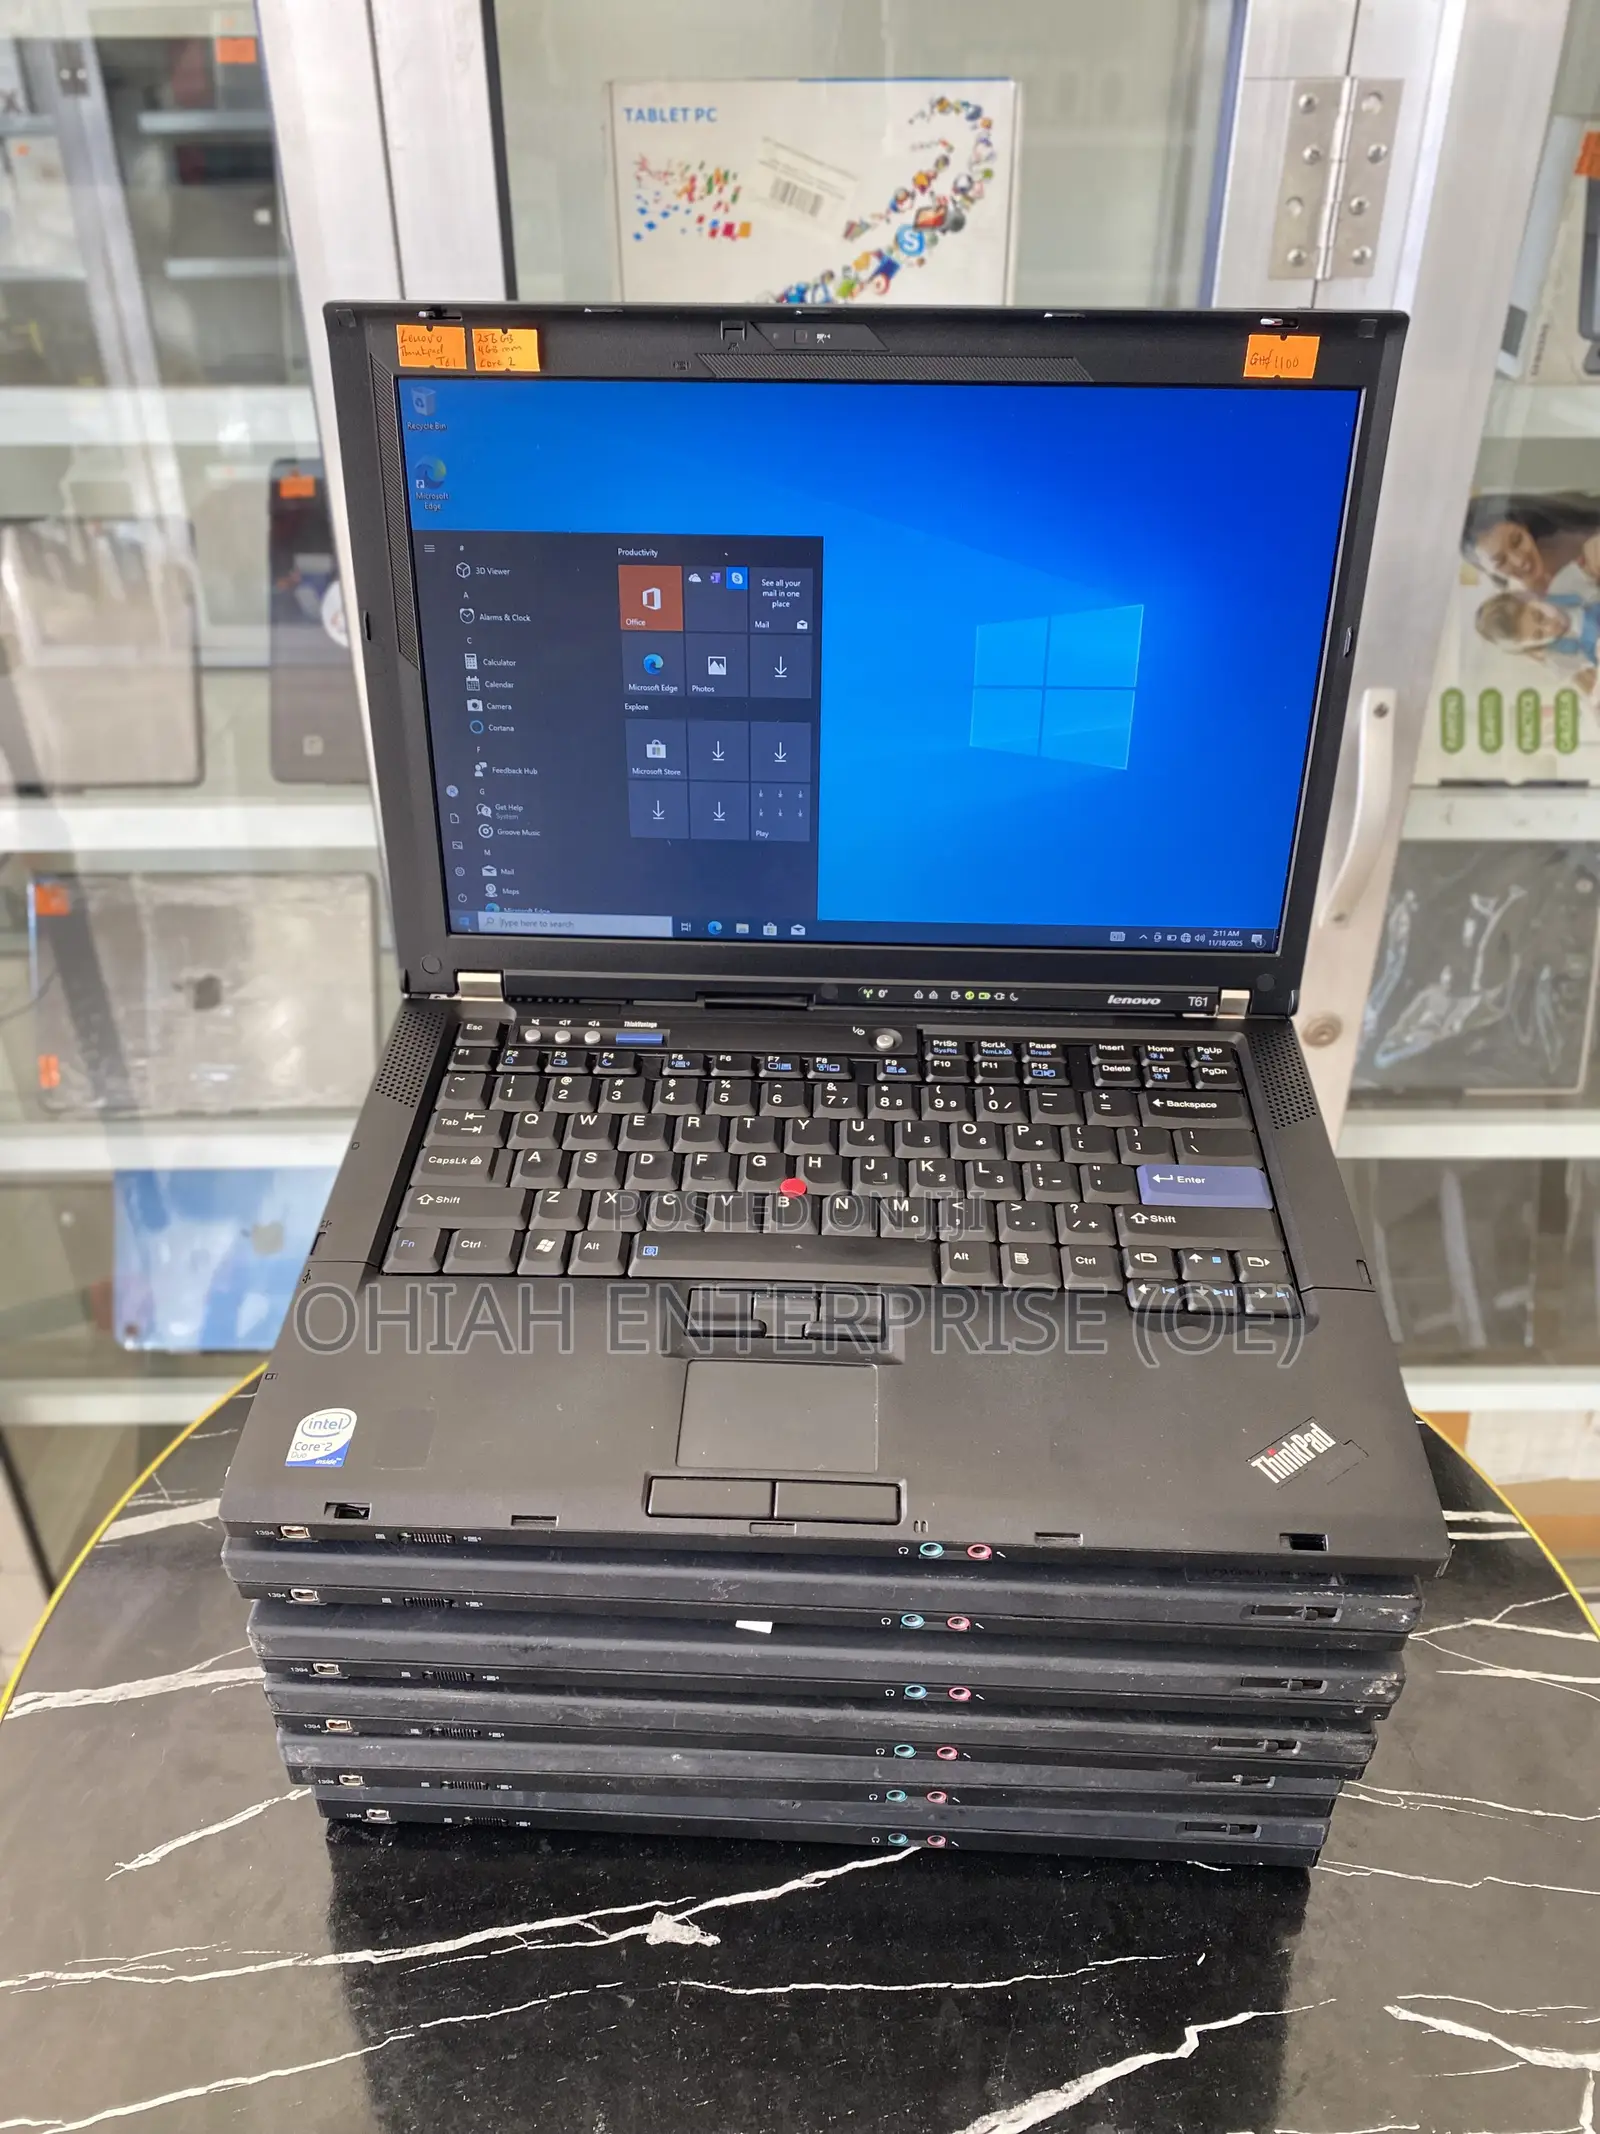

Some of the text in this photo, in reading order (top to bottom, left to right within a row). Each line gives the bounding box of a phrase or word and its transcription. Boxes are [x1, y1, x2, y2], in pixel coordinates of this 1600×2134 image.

[624, 107, 718, 123] TABLET PC
[1275, 356, 1299, 370] 1100
[407, 421, 447, 431] Recycle Bin
[416, 492, 449, 500] Microsoft
[424, 502, 441, 511] Edge
[617, 548, 658, 558] Productivity
[475, 567, 511, 575] 3D Viewer
[761, 578, 801, 589] See all your
[762, 589, 778, 598] mail
[779, 590, 786, 598] in
[772, 600, 790, 609] place
[479, 613, 503, 622] Alarms
[511, 614, 531, 622] Clock
[625, 618, 646, 626] Office
[754, 621, 770, 629] Mail
[483, 659, 516, 667] Calculator
[484, 680, 515, 689] Calendar
[628, 684, 678, 694] Microsoft Edge
[691, 684, 715, 693] Photos
[486, 703, 513, 711] Camera
[624, 703, 649, 712] Explore
[488, 724, 515, 732] Cortana
[491, 766, 538, 775] Feedback Hub
[632, 767, 681, 776] Microsoft Store
[495, 804, 524, 813] Get Help
[497, 829, 541, 837] Groove Music
[755, 830, 769, 839] Play
[500, 867, 515, 875] Mail
[502, 888, 520, 897] Maps
[500, 918, 574, 929] Type here to search
[1208, 939, 1243, 947] 11/18/2025
[1107, 994, 1161, 1005] lenovo
[1188, 996, 1208, 1007] T61
[466, 1023, 483, 1031] Esc
[933, 1039, 958, 1047] PrtSc
[1028, 1041, 1057, 1049] Pause
[457, 1048, 470, 1056] F1
[1196, 1046, 1222, 1055] PgUp
[933, 1060, 951, 1068] F10
[1031, 1062, 1049, 1070] F12
[1101, 1064, 1131, 1072] Delete
[1201, 1067, 1228, 1076] PgDn
[506, 1089, 513, 1097] 1
[557, 1090, 567, 1099] 2
[611, 1091, 621, 1100] 3
[665, 1091, 675, 1101] 4
[719, 1092, 729, 1102] 5
[772, 1094, 782, 1104] 6
[826, 1095, 836, 1105] 7
[879, 1097, 890, 1107] 8
[934, 1099, 944, 1108] 9
[1166, 1100, 1217, 1109] Backspace
[440, 1118, 459, 1126] Tab
[524, 1113, 539, 1125] Q
[579, 1115, 597, 1125] W
[633, 1115, 645, 1126] E
[687, 1117, 701, 1127] R
[742, 1118, 756, 1129] T
[797, 1119, 810, 1130] Y
[852, 1121, 864, 1131] U
[963, 1124, 977, 1135] O
[1017, 1125, 1029, 1136] P
[428, 1155, 467, 1166] CapsLk
[527, 1151, 541, 1162] A
[584, 1153, 597, 1163] S
[640, 1153, 654, 1164] D
[696, 1154, 708, 1165] F
[752, 1155, 767, 1167] G
[807, 1156, 822, 1168] H
[865, 1159, 875, 1171] J
[921, 1161, 934, 1172] K
[978, 1162, 989, 1173] L
[1176, 1175, 1206, 1184] Enter
[435, 1195, 461, 1204] Shift
[547, 1191, 559, 1202] Z
[604, 1192, 617, 1203] X
[662, 1193, 676, 1205] C
[720, 1194, 734, 1206] V
[777, 1196, 790, 1207] B
[835, 1199, 849, 1210] N
[893, 1200, 909, 1212] M
[1149, 1214, 1177, 1224] Shift
[400, 1239, 415, 1247] Fn
[460, 1240, 481, 1248] Ctrl
[584, 1241, 600, 1250] Alt
[953, 1252, 969, 1261] Alt
[1075, 1255, 1096, 1264] Ctrl
[308, 1418, 344, 1430] intel
[324, 1443, 333, 1452] 2
[291, 1451, 308, 1459] Duo
[1251, 1422, 1336, 1484] ThinkPad
